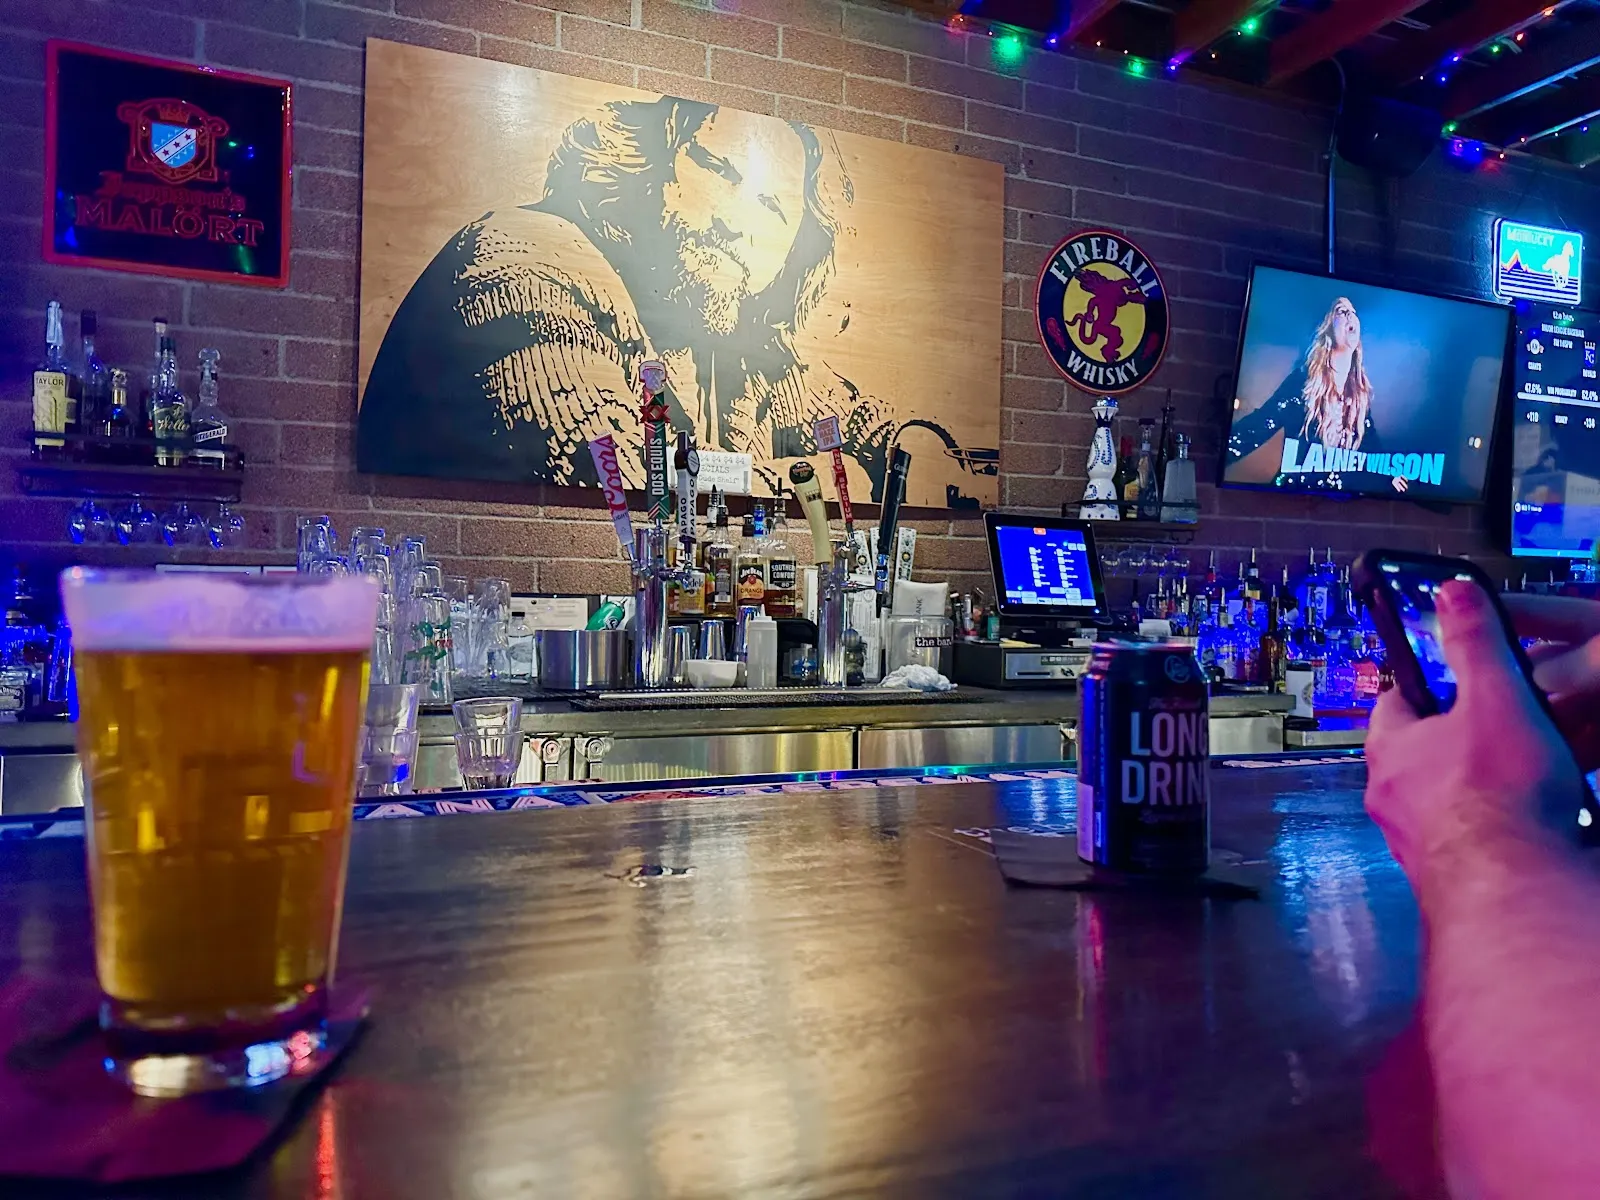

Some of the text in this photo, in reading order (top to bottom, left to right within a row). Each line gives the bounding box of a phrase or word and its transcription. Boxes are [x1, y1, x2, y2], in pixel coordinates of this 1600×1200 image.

[1049, 237, 1159, 298] FIREBALL
[36, 377, 64, 386] TAYLOR
[1066, 350, 1140, 386] WHISKY
[650, 437, 665, 496] DOS EQUIS
[701, 464, 730, 474] ECIALS
[1281, 437, 1445, 486] LAINEY WILSON
[834, 452, 851, 519] NEW BELGIUM
[772, 571, 795, 579] COMFOR
[915, 637, 935, 647] the
[1121, 758, 1208, 807] DRIN
